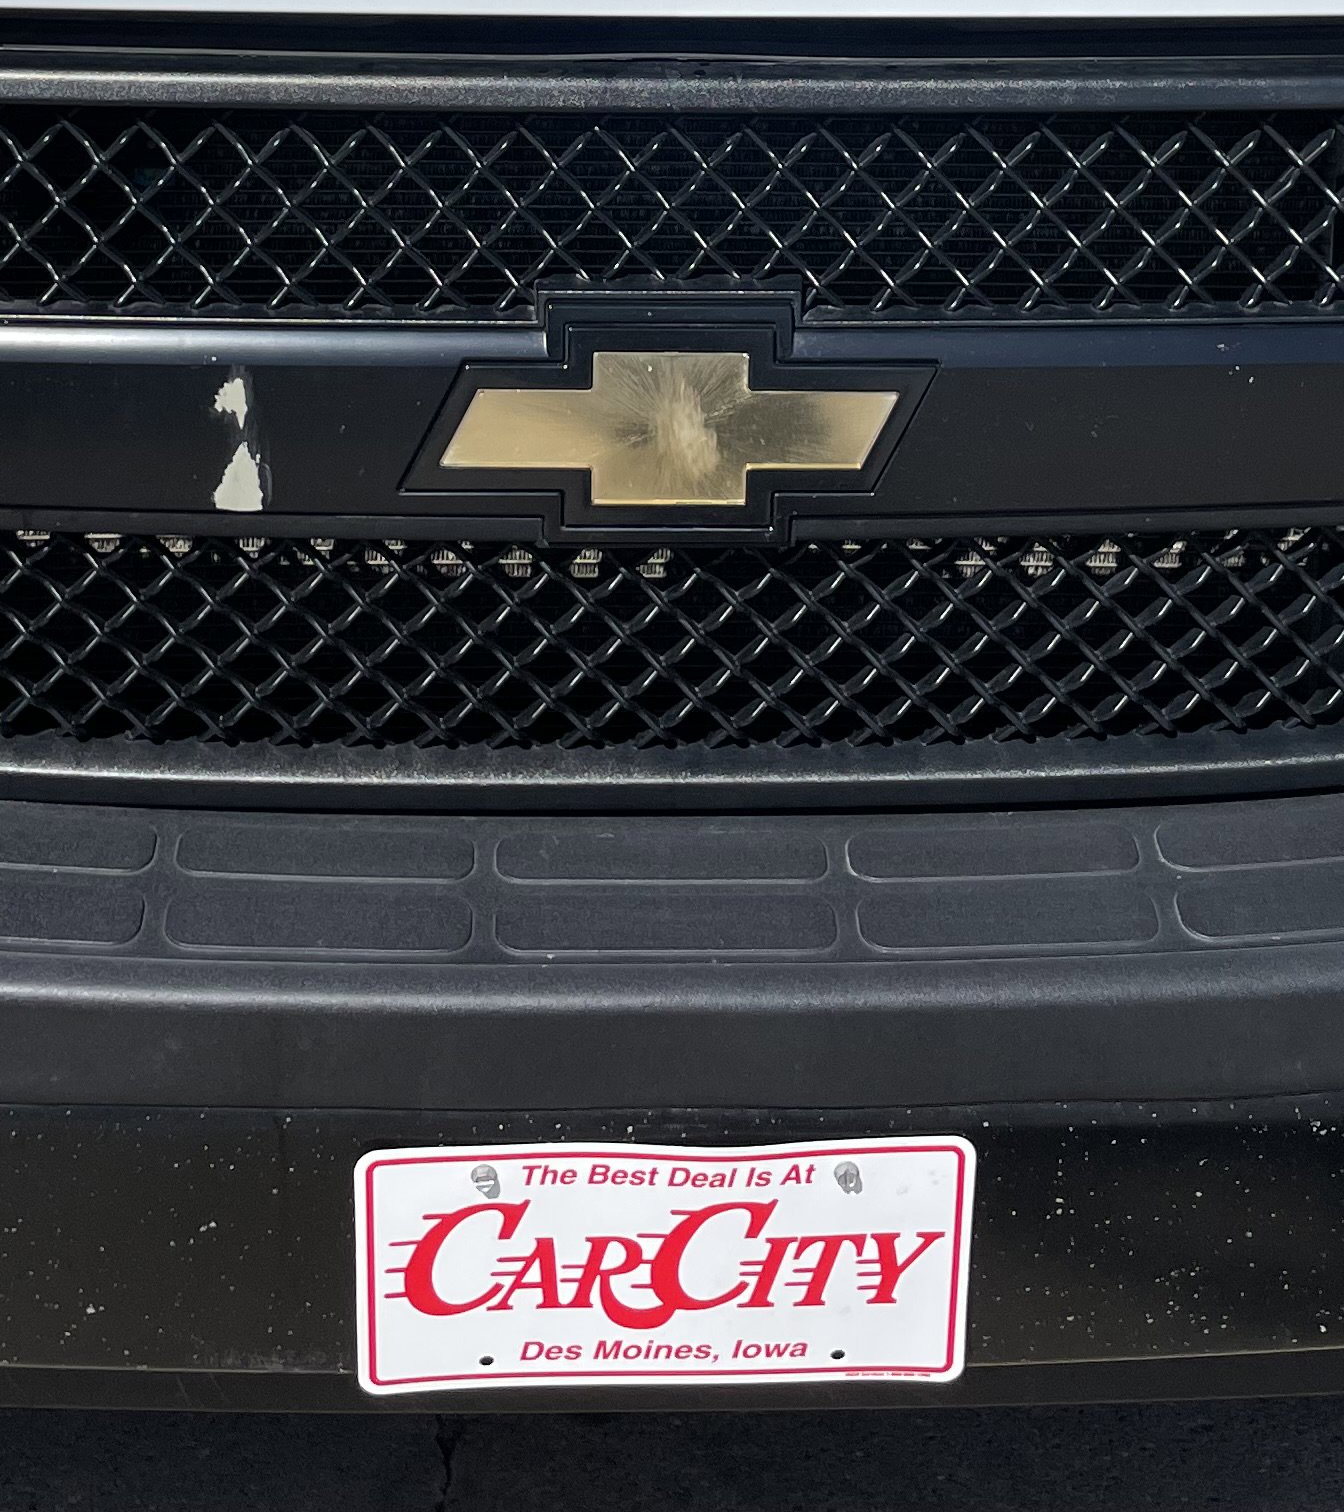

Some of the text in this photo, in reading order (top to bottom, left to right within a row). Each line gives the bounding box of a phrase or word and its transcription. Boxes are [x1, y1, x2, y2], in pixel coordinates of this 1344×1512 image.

[522, 1163, 817, 1188] The Best Deal Is At
[520, 1339, 808, 1363] Des Moines, Iowa
